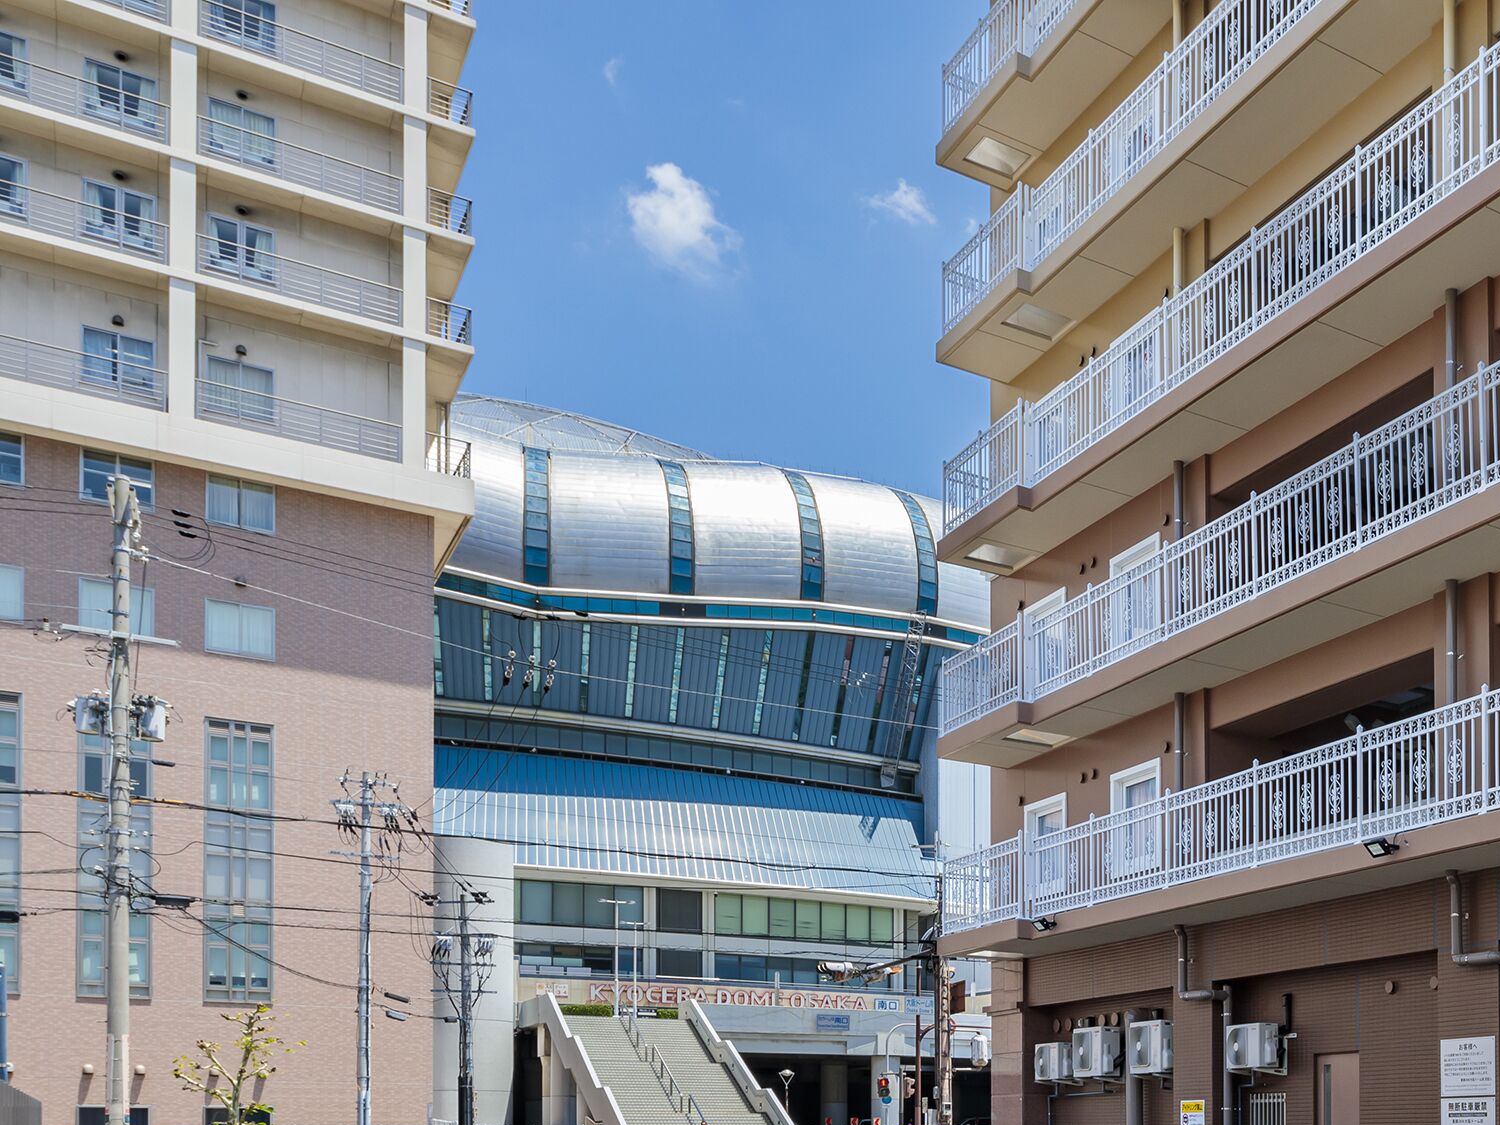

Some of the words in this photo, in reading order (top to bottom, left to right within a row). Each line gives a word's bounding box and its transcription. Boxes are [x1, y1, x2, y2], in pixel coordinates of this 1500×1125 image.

[590, 983, 708, 1004] KYOCERA
[790, 992, 868, 1010] OSAKA
[877, 1000, 898, 1010] 南口
